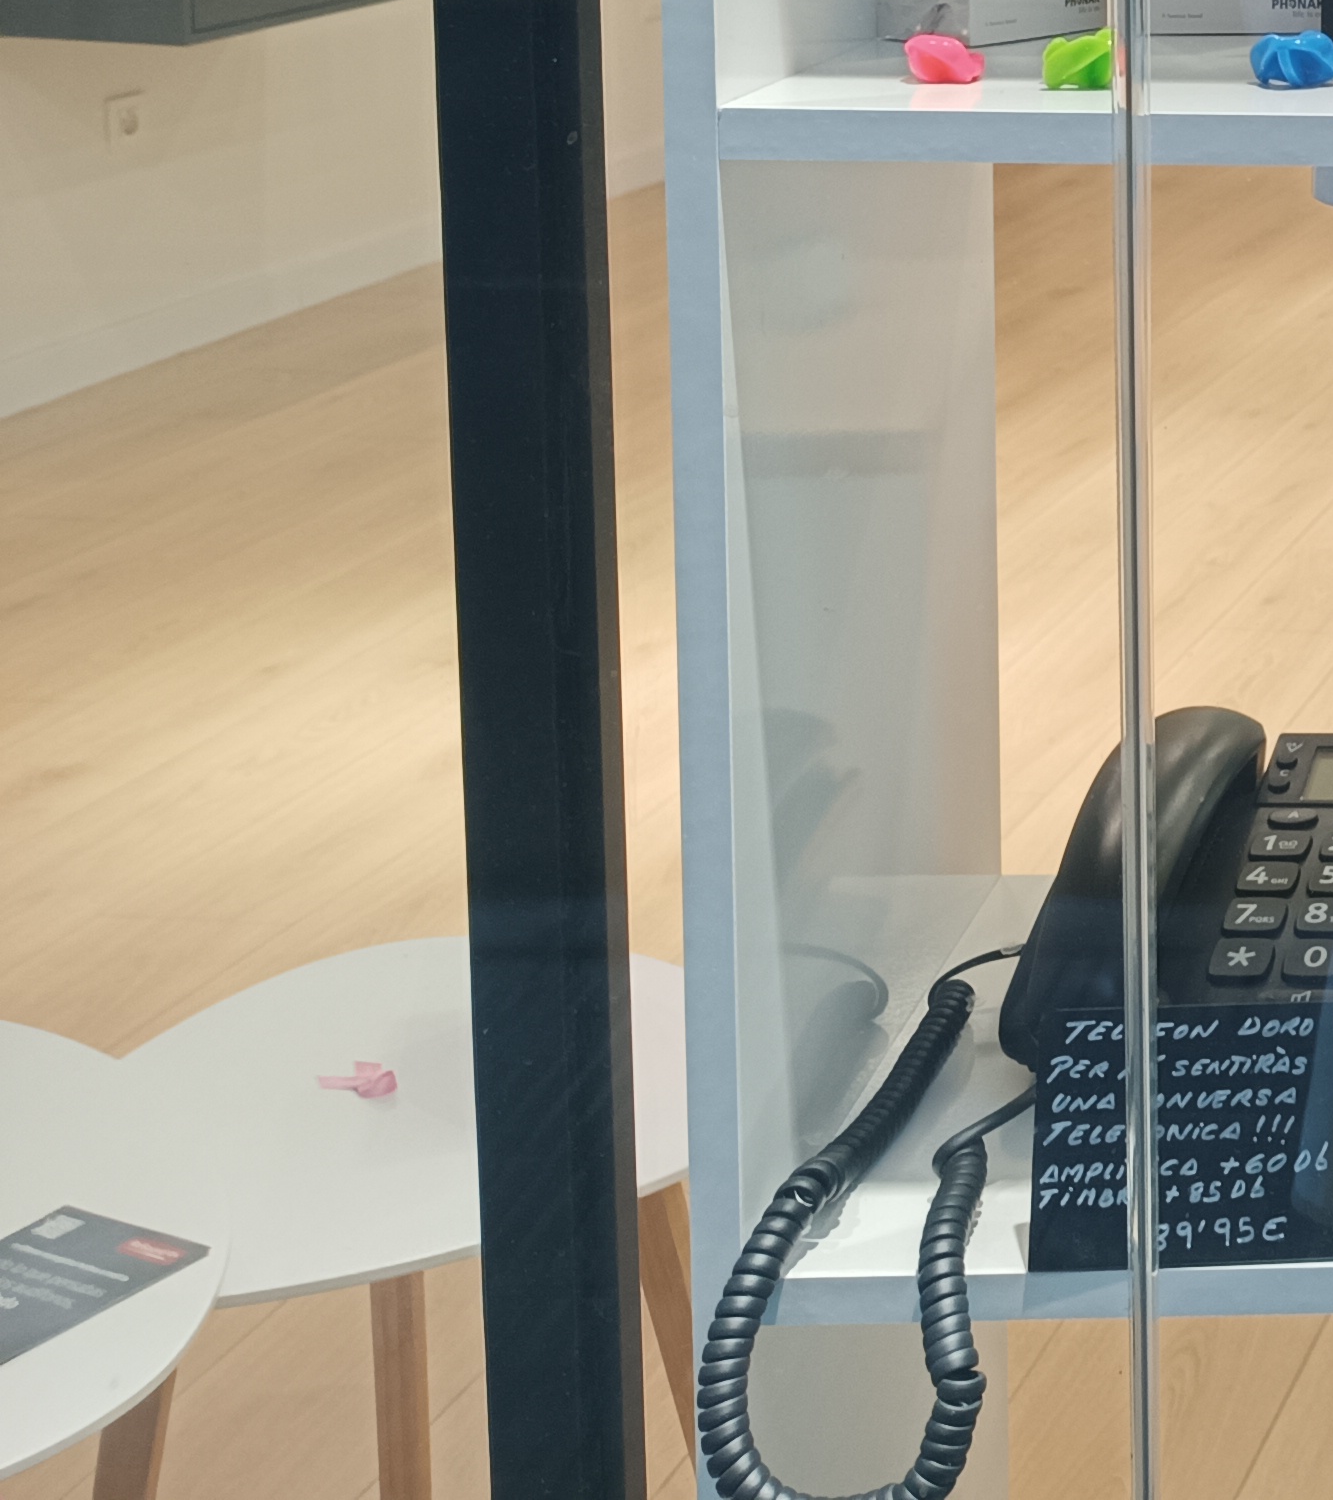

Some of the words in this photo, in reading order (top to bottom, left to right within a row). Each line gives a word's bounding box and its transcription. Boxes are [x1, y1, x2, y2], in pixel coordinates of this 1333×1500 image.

[1263, 834, 1277, 851] 1
[1245, 866, 1269, 885] 4
[1234, 903, 1258, 925] 7
[1304, 902, 1329, 924] 8
[1303, 945, 1328, 968] 0
[1065, 1019, 1218, 1045] TELFON
[1237, 1016, 1314, 1038] DORO
[1047, 1055, 1109, 1084] PER
[1052, 1092, 1115, 1113] UNA
